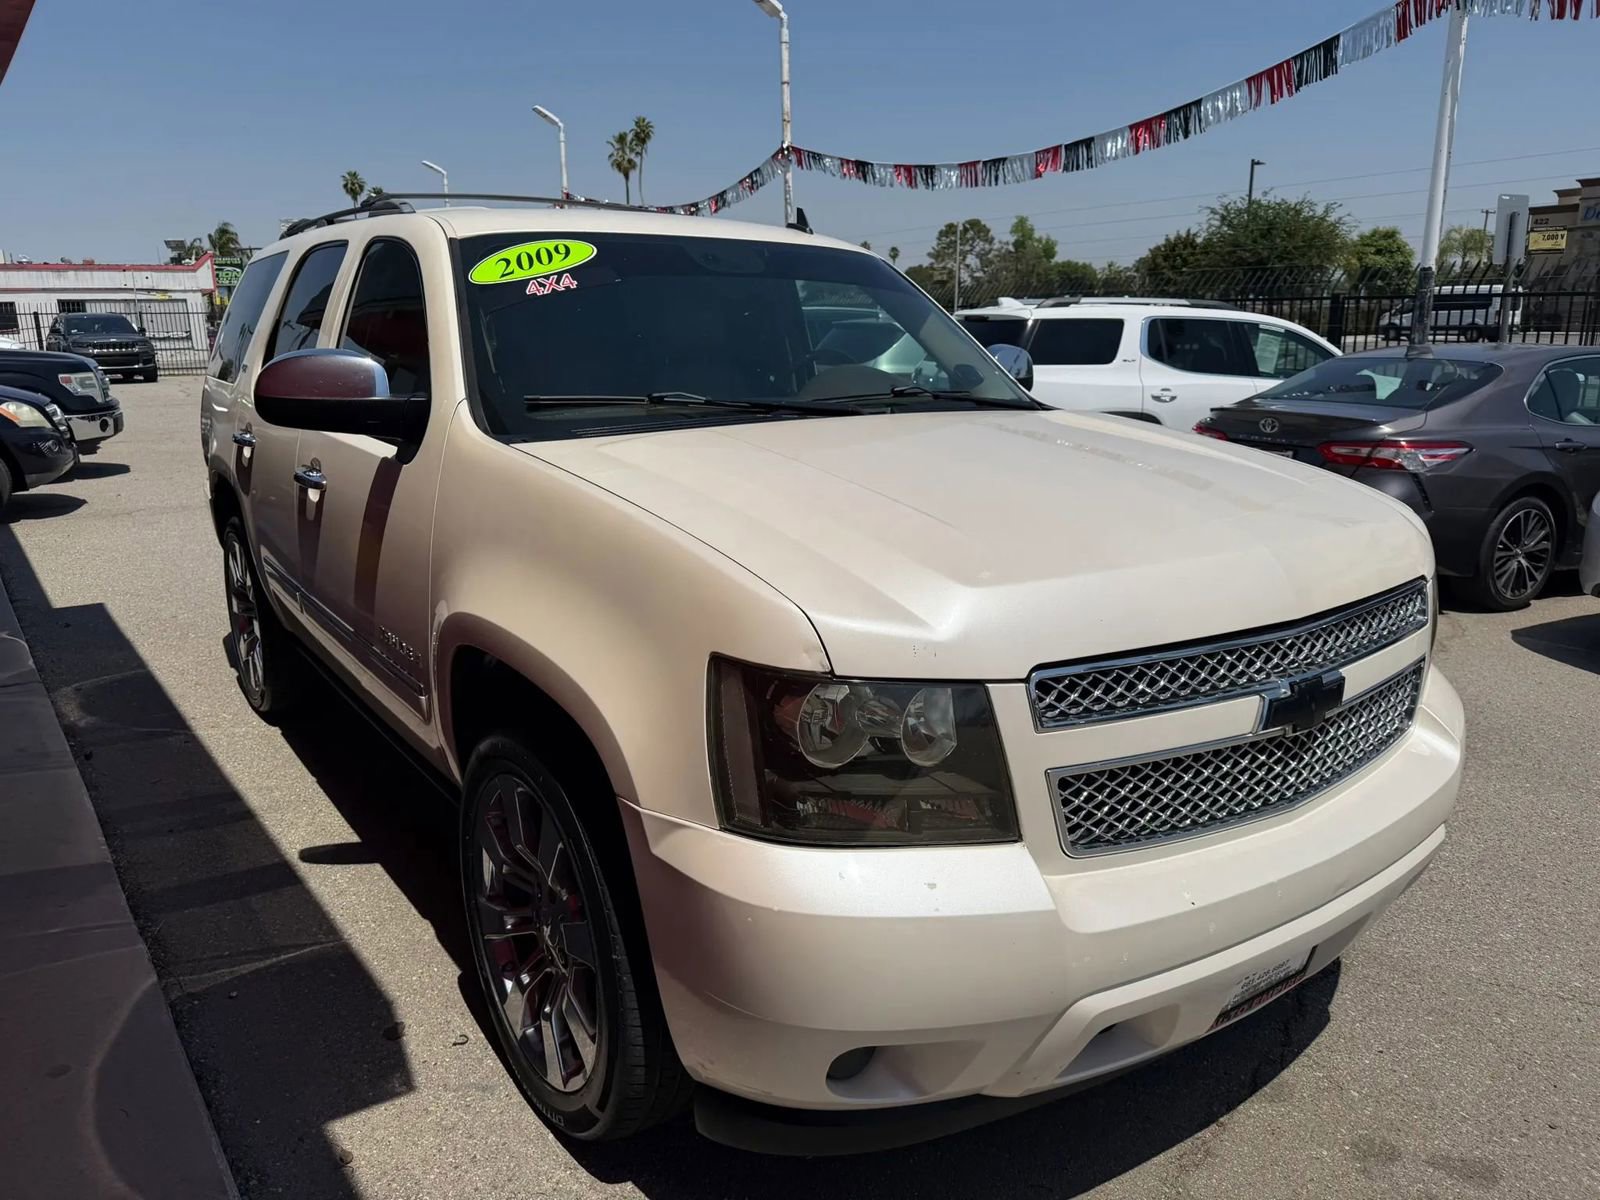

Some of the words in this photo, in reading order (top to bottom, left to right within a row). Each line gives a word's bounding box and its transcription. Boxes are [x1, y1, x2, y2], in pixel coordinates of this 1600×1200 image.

[1542, 234, 1559, 242] 7,000
[1560, 233, 1566, 241] V
[495, 243, 571, 278] 2009
[526, 273, 578, 296] 4X4
